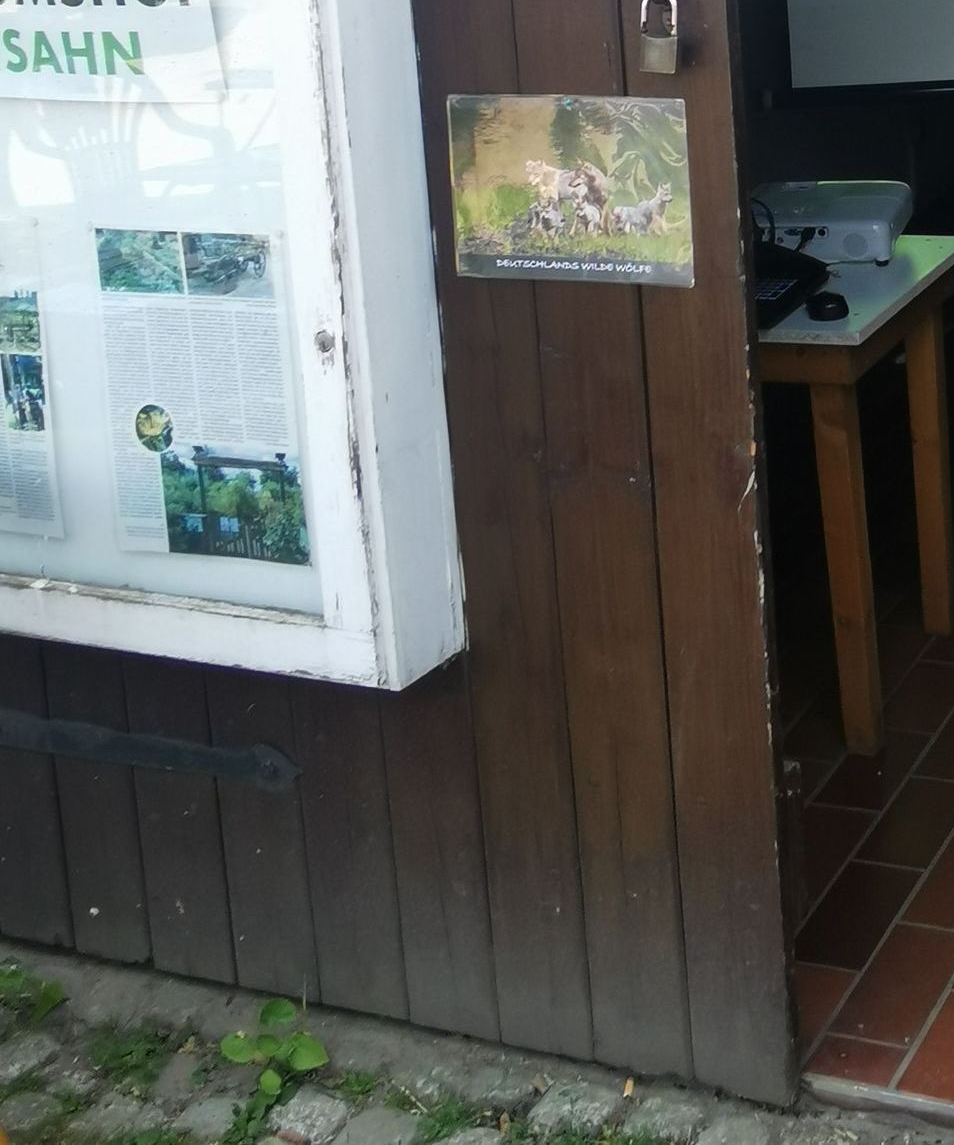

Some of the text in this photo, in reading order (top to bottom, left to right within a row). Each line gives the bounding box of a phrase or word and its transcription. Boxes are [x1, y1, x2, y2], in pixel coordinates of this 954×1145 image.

[2, 28, 145, 75] SAHN
[496, 259, 652, 273] DEUTSCHLANDS WILDE WÖLFE
